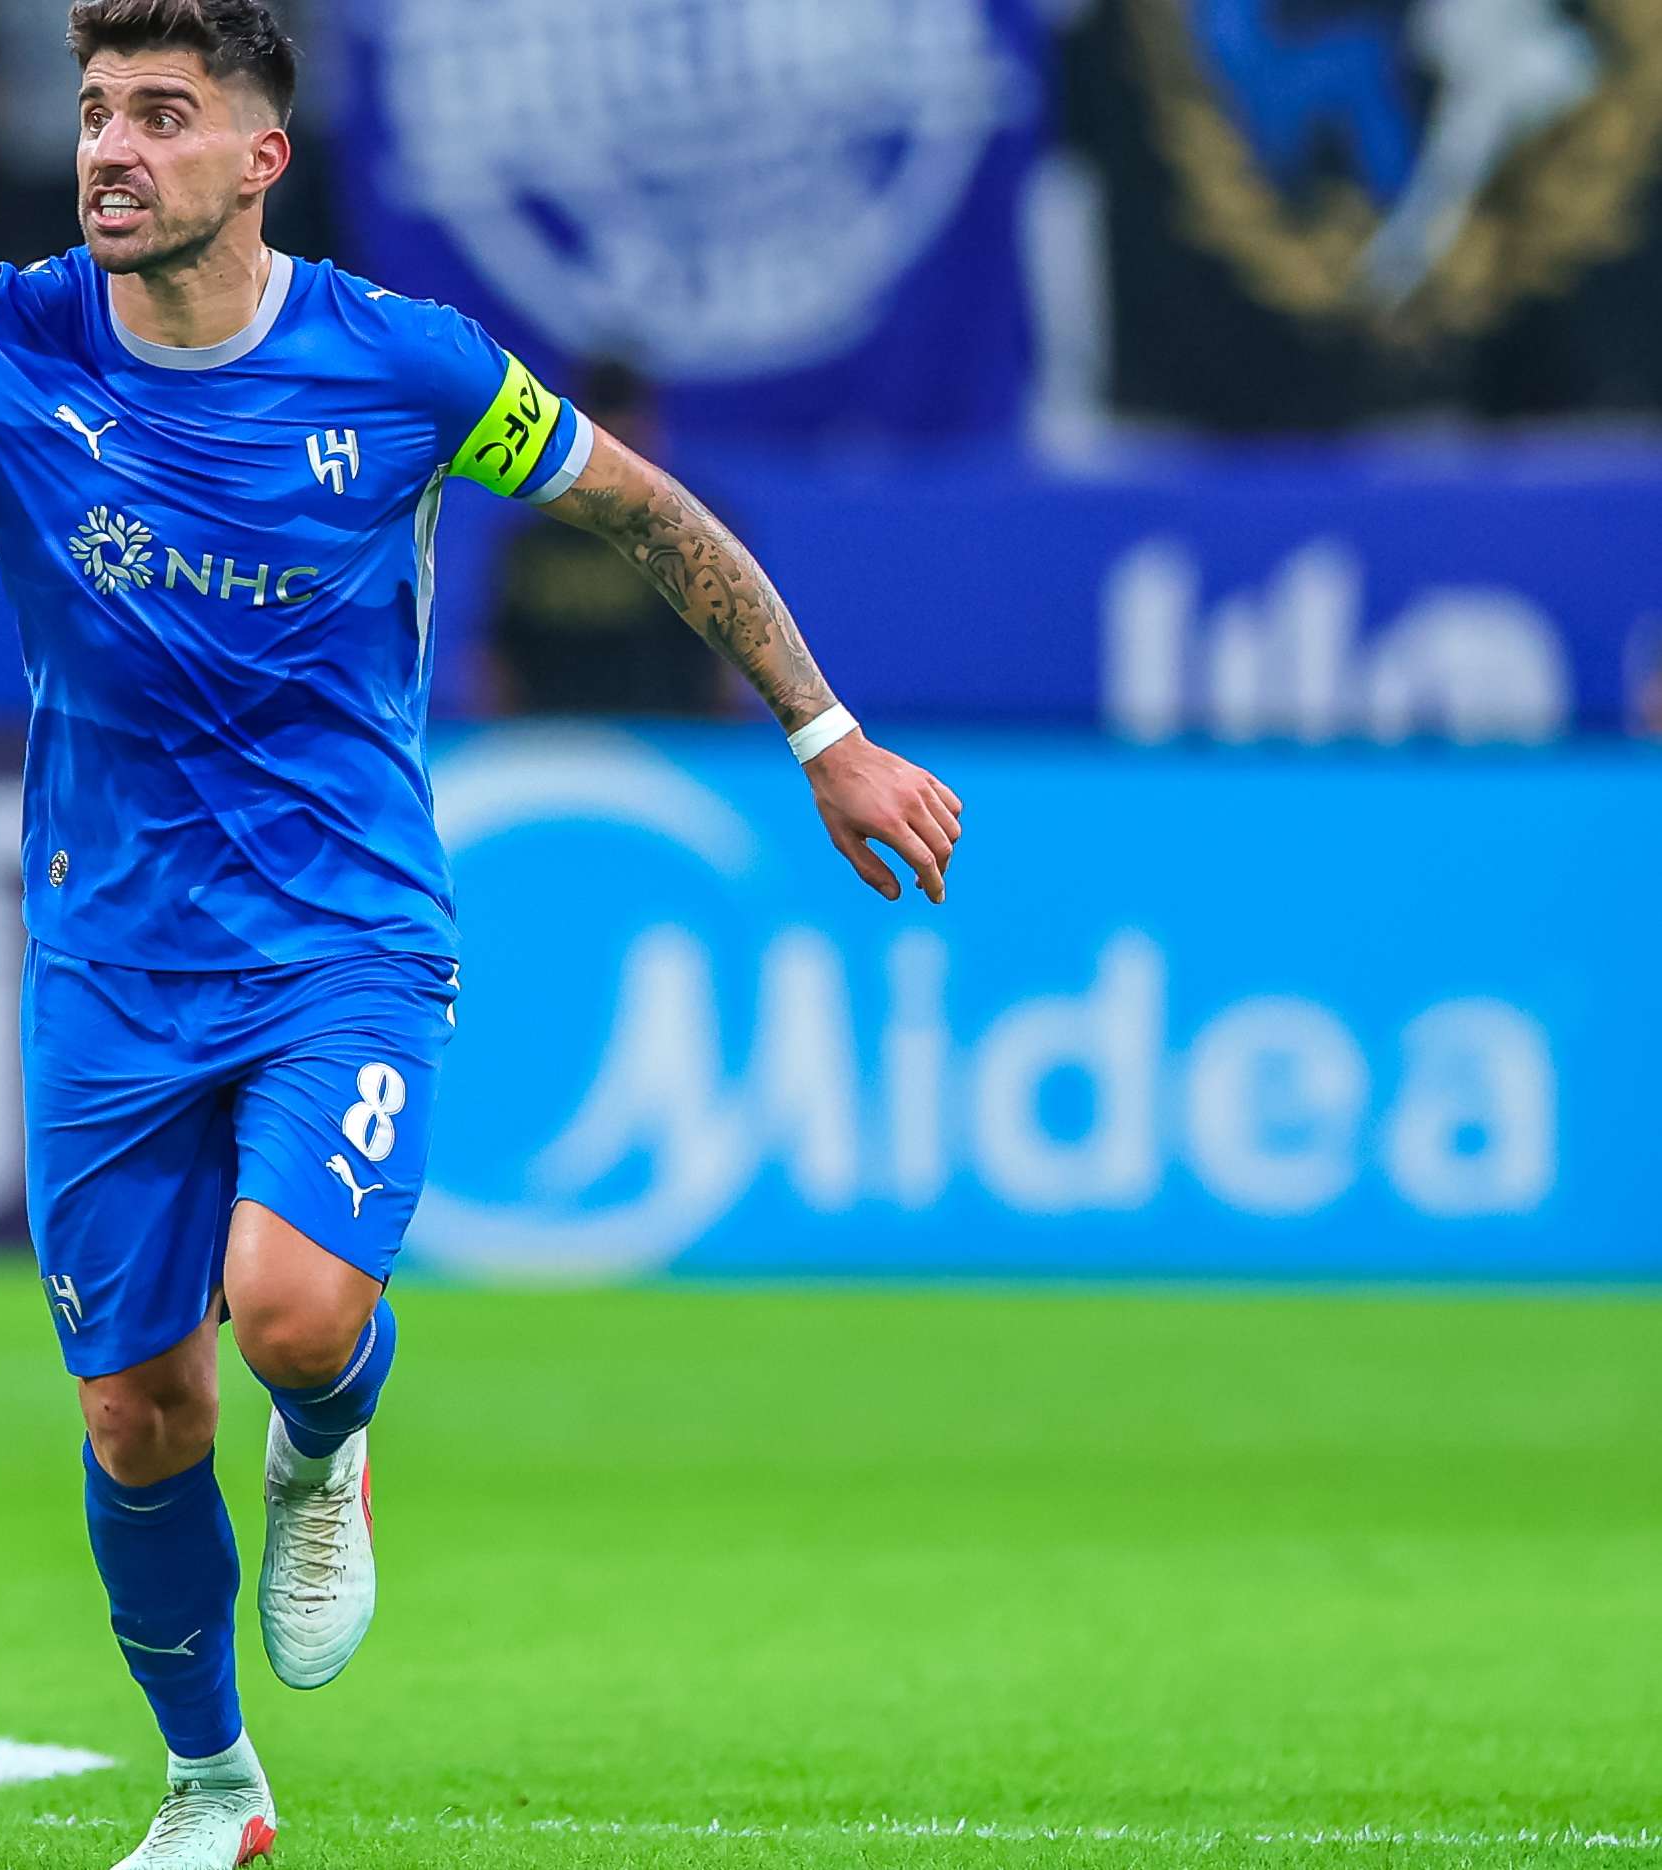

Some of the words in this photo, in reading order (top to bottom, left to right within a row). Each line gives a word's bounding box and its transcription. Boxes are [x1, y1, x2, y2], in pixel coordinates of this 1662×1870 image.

[164, 547, 319, 606] NHC
[342, 1062, 406, 1162] 8
[533, 925, 1560, 1218] Midea
